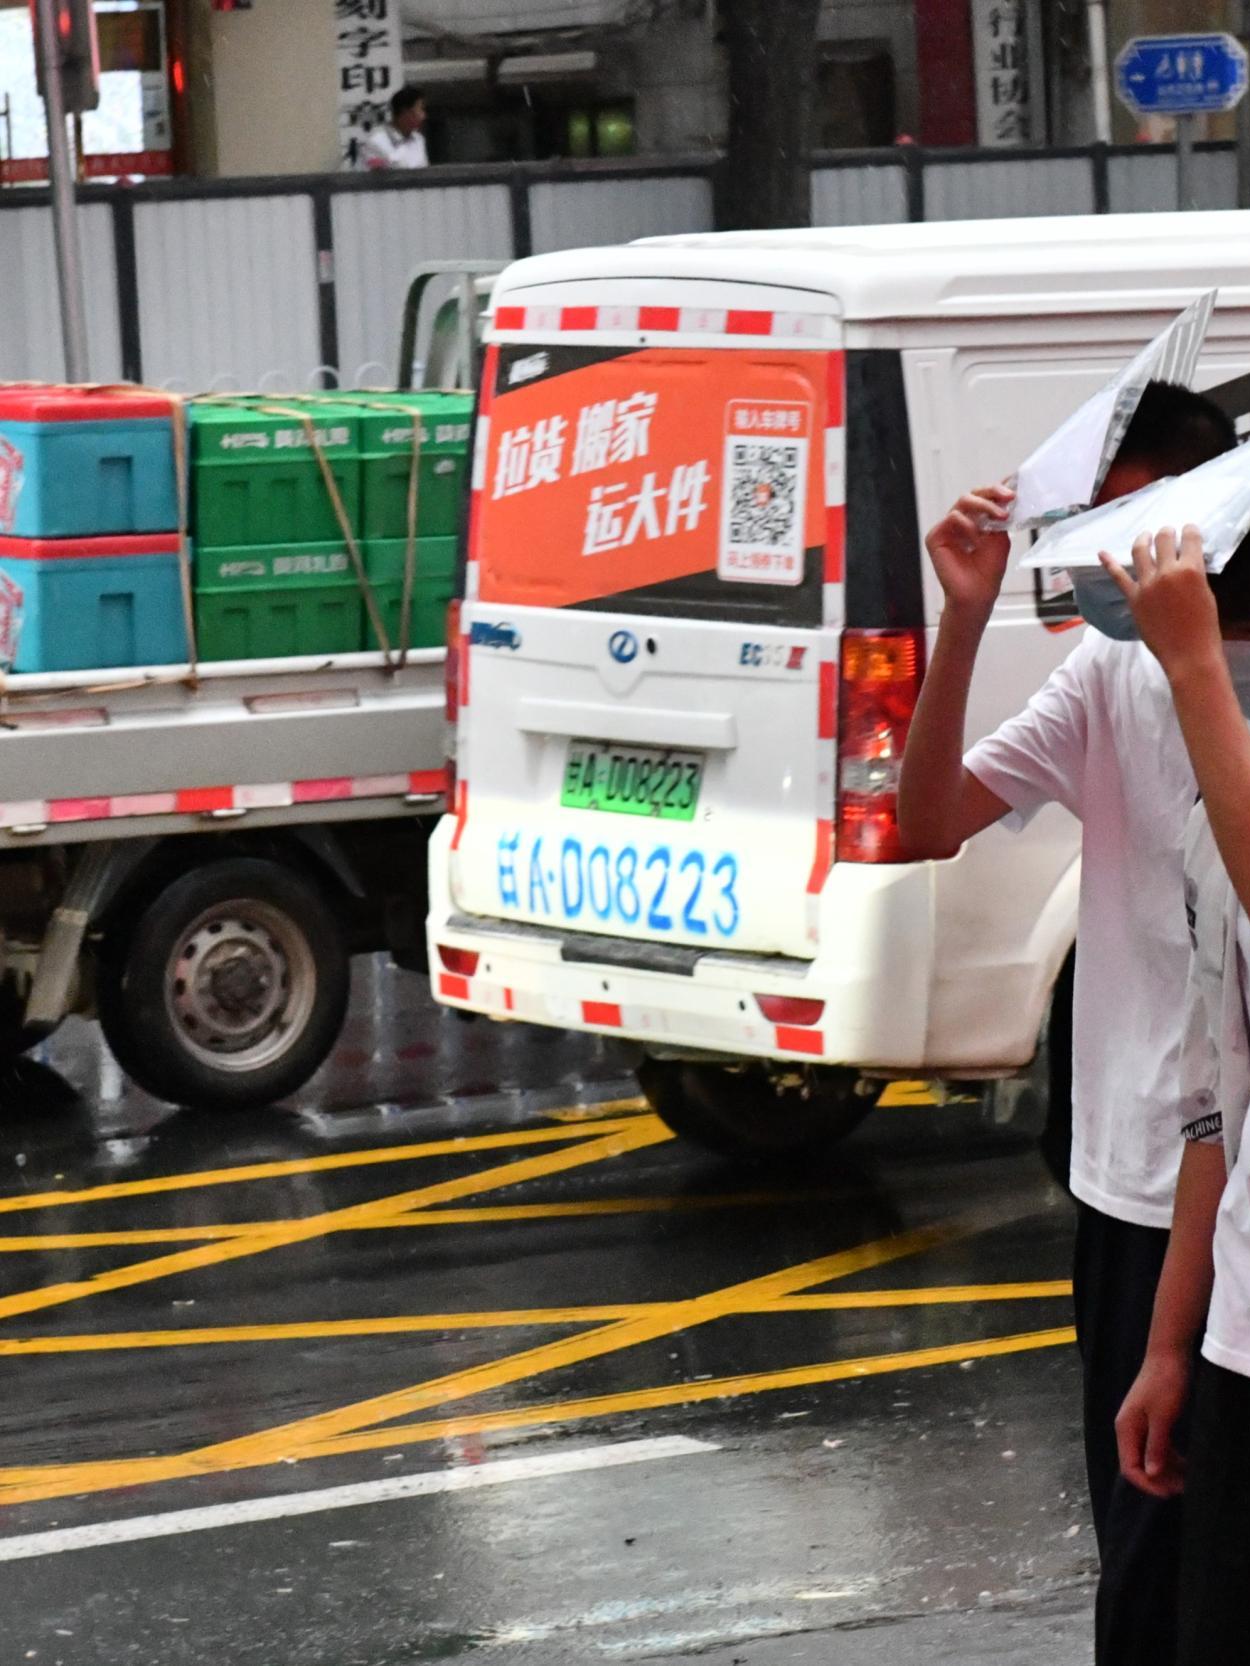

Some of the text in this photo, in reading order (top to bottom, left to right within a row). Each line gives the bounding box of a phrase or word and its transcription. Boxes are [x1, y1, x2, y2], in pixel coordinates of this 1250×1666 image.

[491, 391, 659, 501] 拉货 搬家
[581, 459, 712, 557] 运大件
